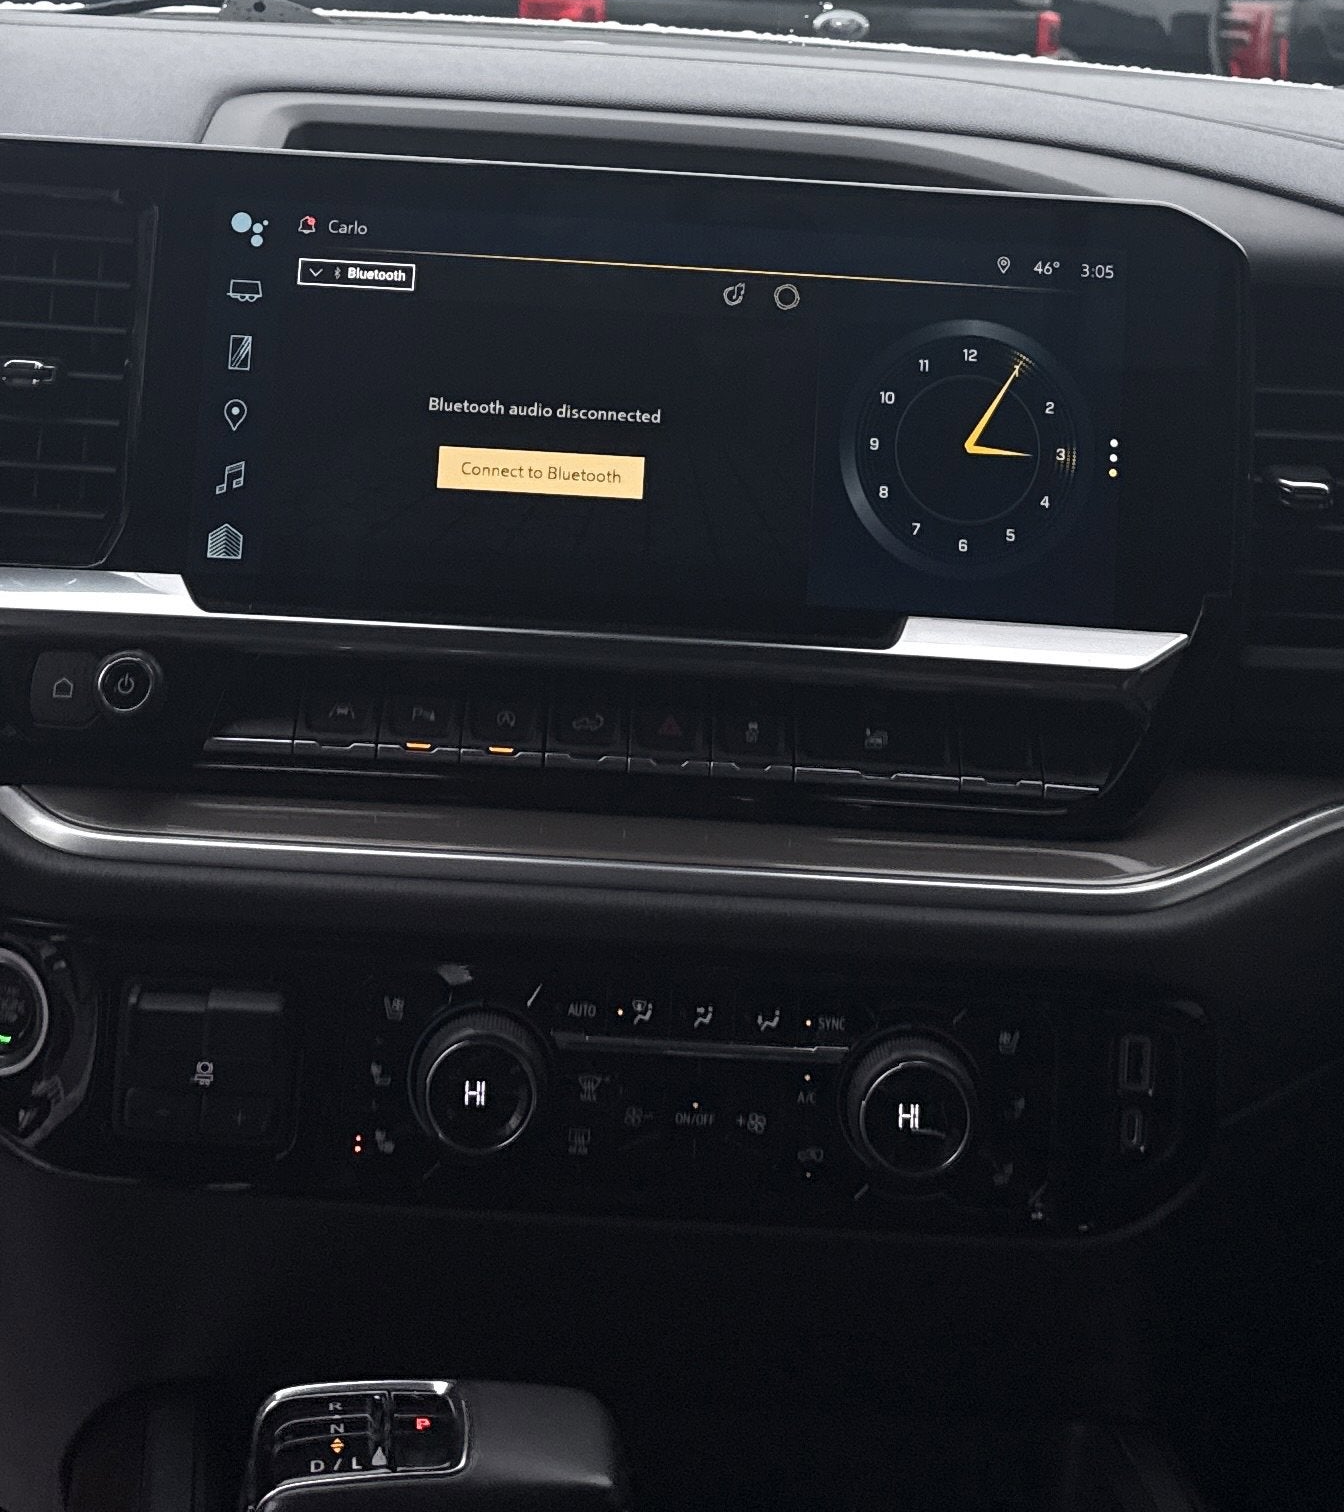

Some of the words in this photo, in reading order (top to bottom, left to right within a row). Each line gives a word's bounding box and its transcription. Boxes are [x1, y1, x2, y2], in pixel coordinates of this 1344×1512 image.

[328, 219, 367, 236] Carlo
[347, 266, 406, 282] Bluetooth
[1080, 263, 1114, 279] 3:05
[962, 348, 978, 363] 12
[918, 359, 929, 373] 11
[879, 391, 896, 405] 10
[428, 396, 505, 415] Bluetooth
[508, 401, 553, 418] audio
[556, 404, 662, 424] disconnected
[1044, 401, 1055, 414] 2
[869, 437, 879, 450] 9
[1055, 448, 1066, 461] 3
[461, 461, 525, 479] Connect
[528, 465, 543, 480] to
[547, 466, 622, 484] Bluetooth
[878, 485, 889, 499] 8
[1039, 495, 1050, 509] 4
[911, 522, 921, 536] 7
[1005, 528, 1016, 542] 5
[957, 539, 968, 552] 6
[567, 1002, 597, 1019] AUTO
[817, 1015, 847, 1031] SYNC
[463, 1079, 486, 1107] HI
[796, 1091, 816, 1106] A/C
[674, 1110, 716, 1127] ON/OFF
[897, 1102, 921, 1131] HI
[328, 1401, 342, 1411] R
[329, 1423, 345, 1434] N
[414, 1418, 431, 1430] P
